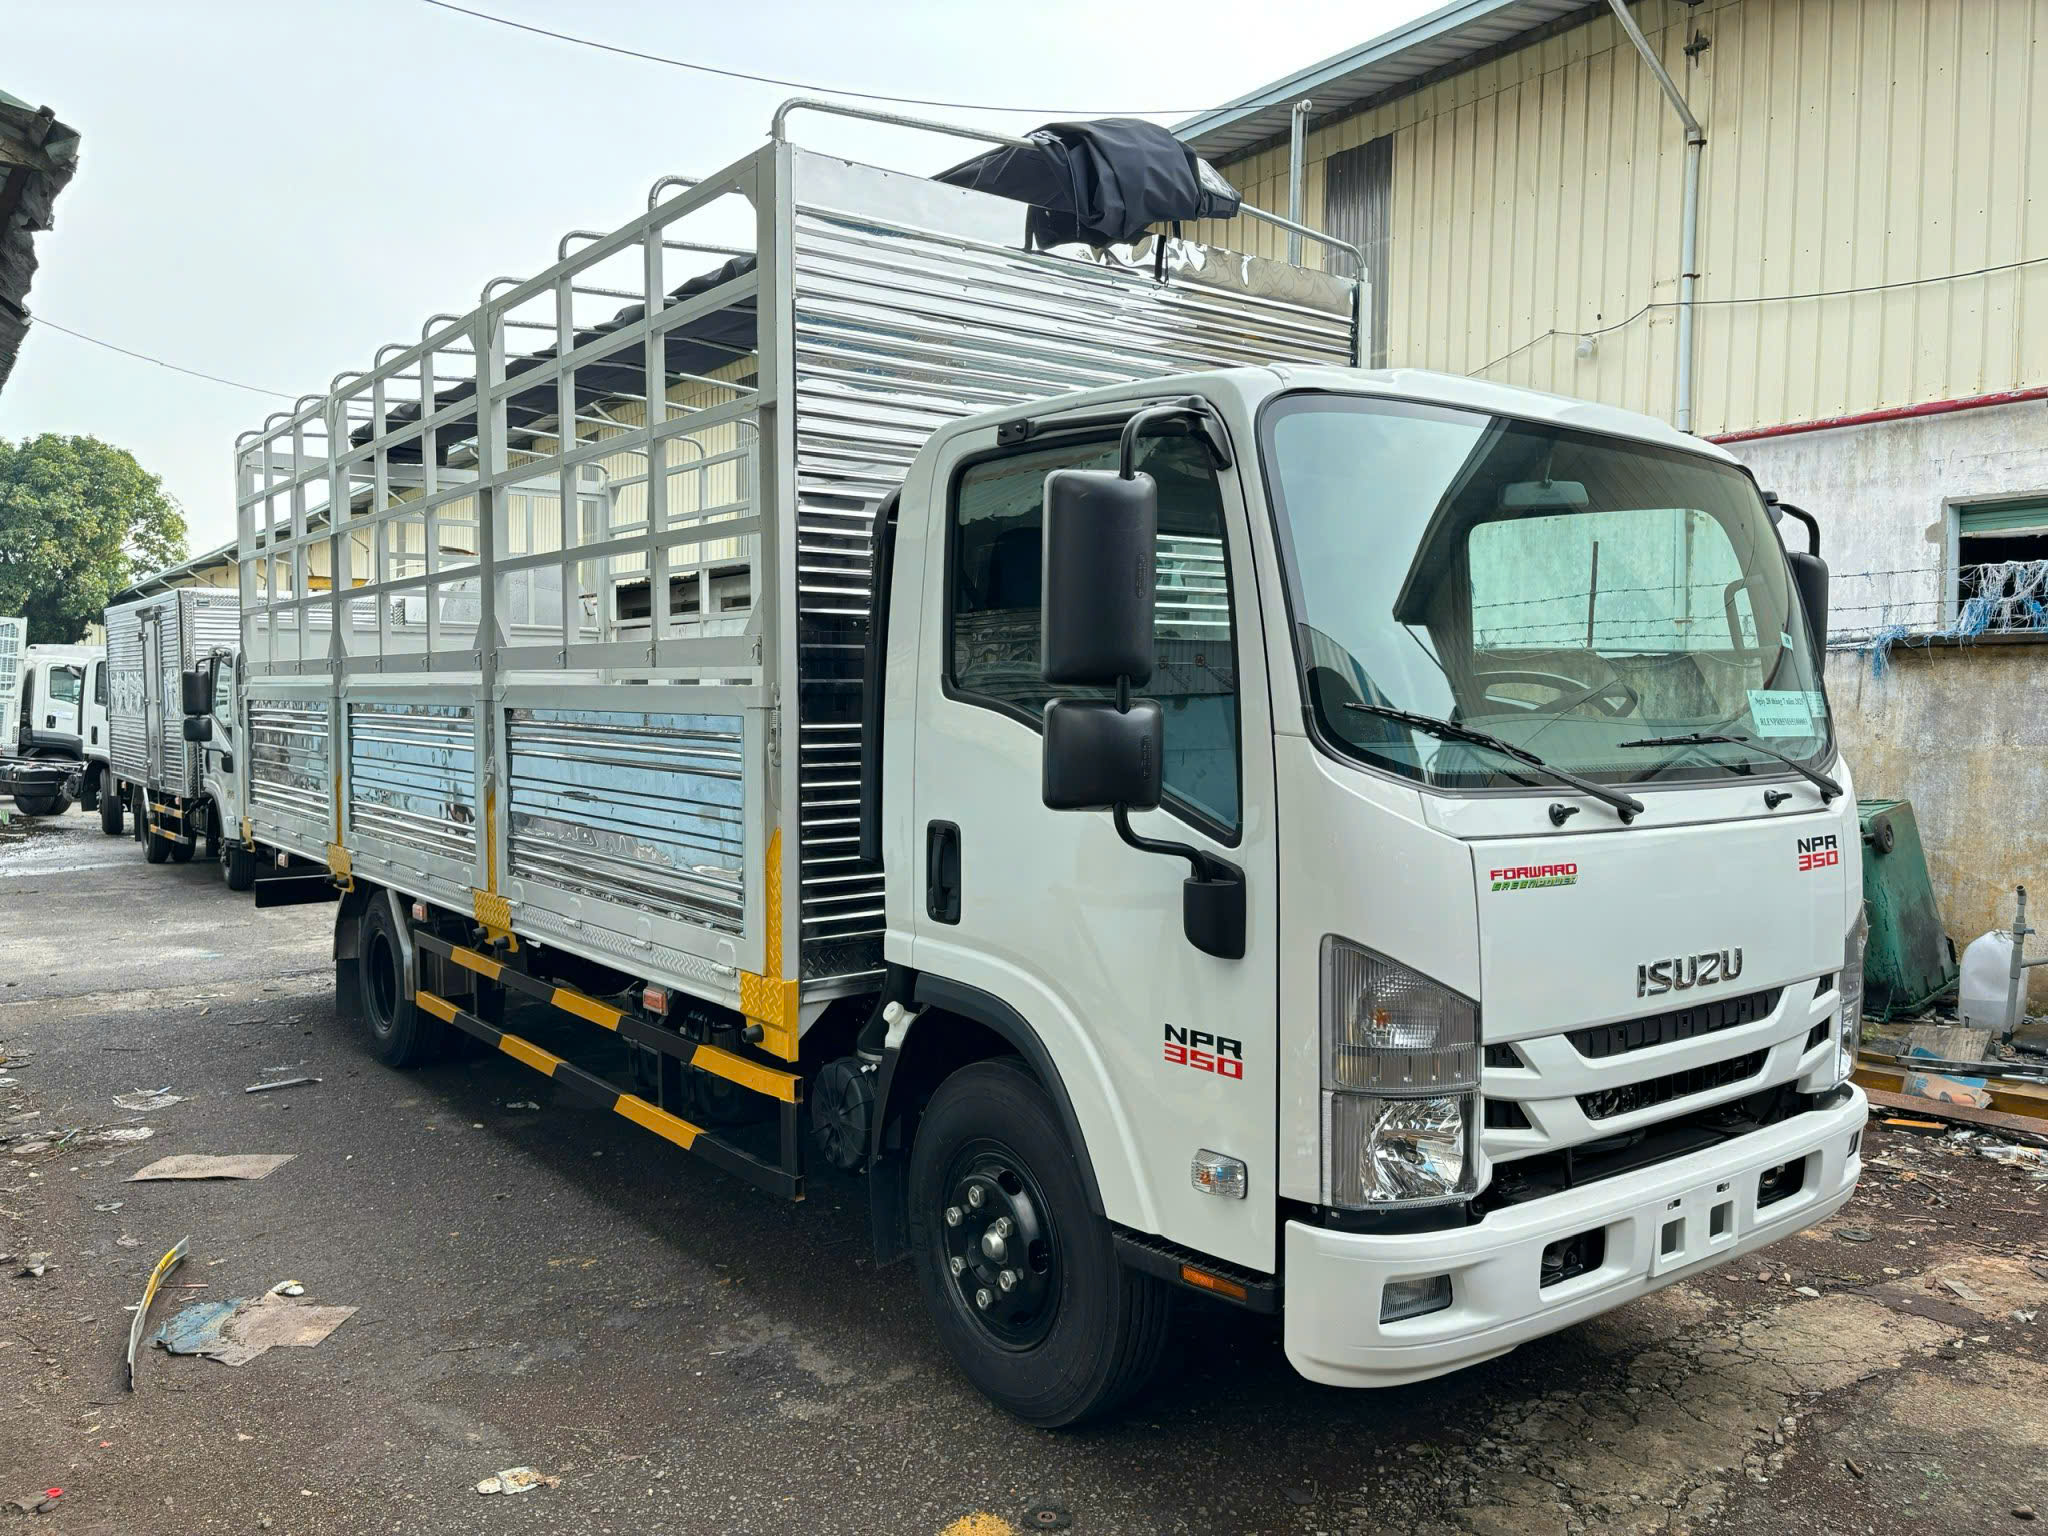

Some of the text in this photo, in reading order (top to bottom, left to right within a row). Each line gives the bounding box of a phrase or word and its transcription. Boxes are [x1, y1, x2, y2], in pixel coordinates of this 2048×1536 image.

[1797, 834, 1837, 854] NPR
[1490, 863, 1577, 881] FORWARD
[1799, 850, 1838, 871] 350
[1636, 946, 1743, 998] ISUZU
[1164, 1023, 1243, 1060] NPR
[1164, 1042, 1243, 1080] 350
